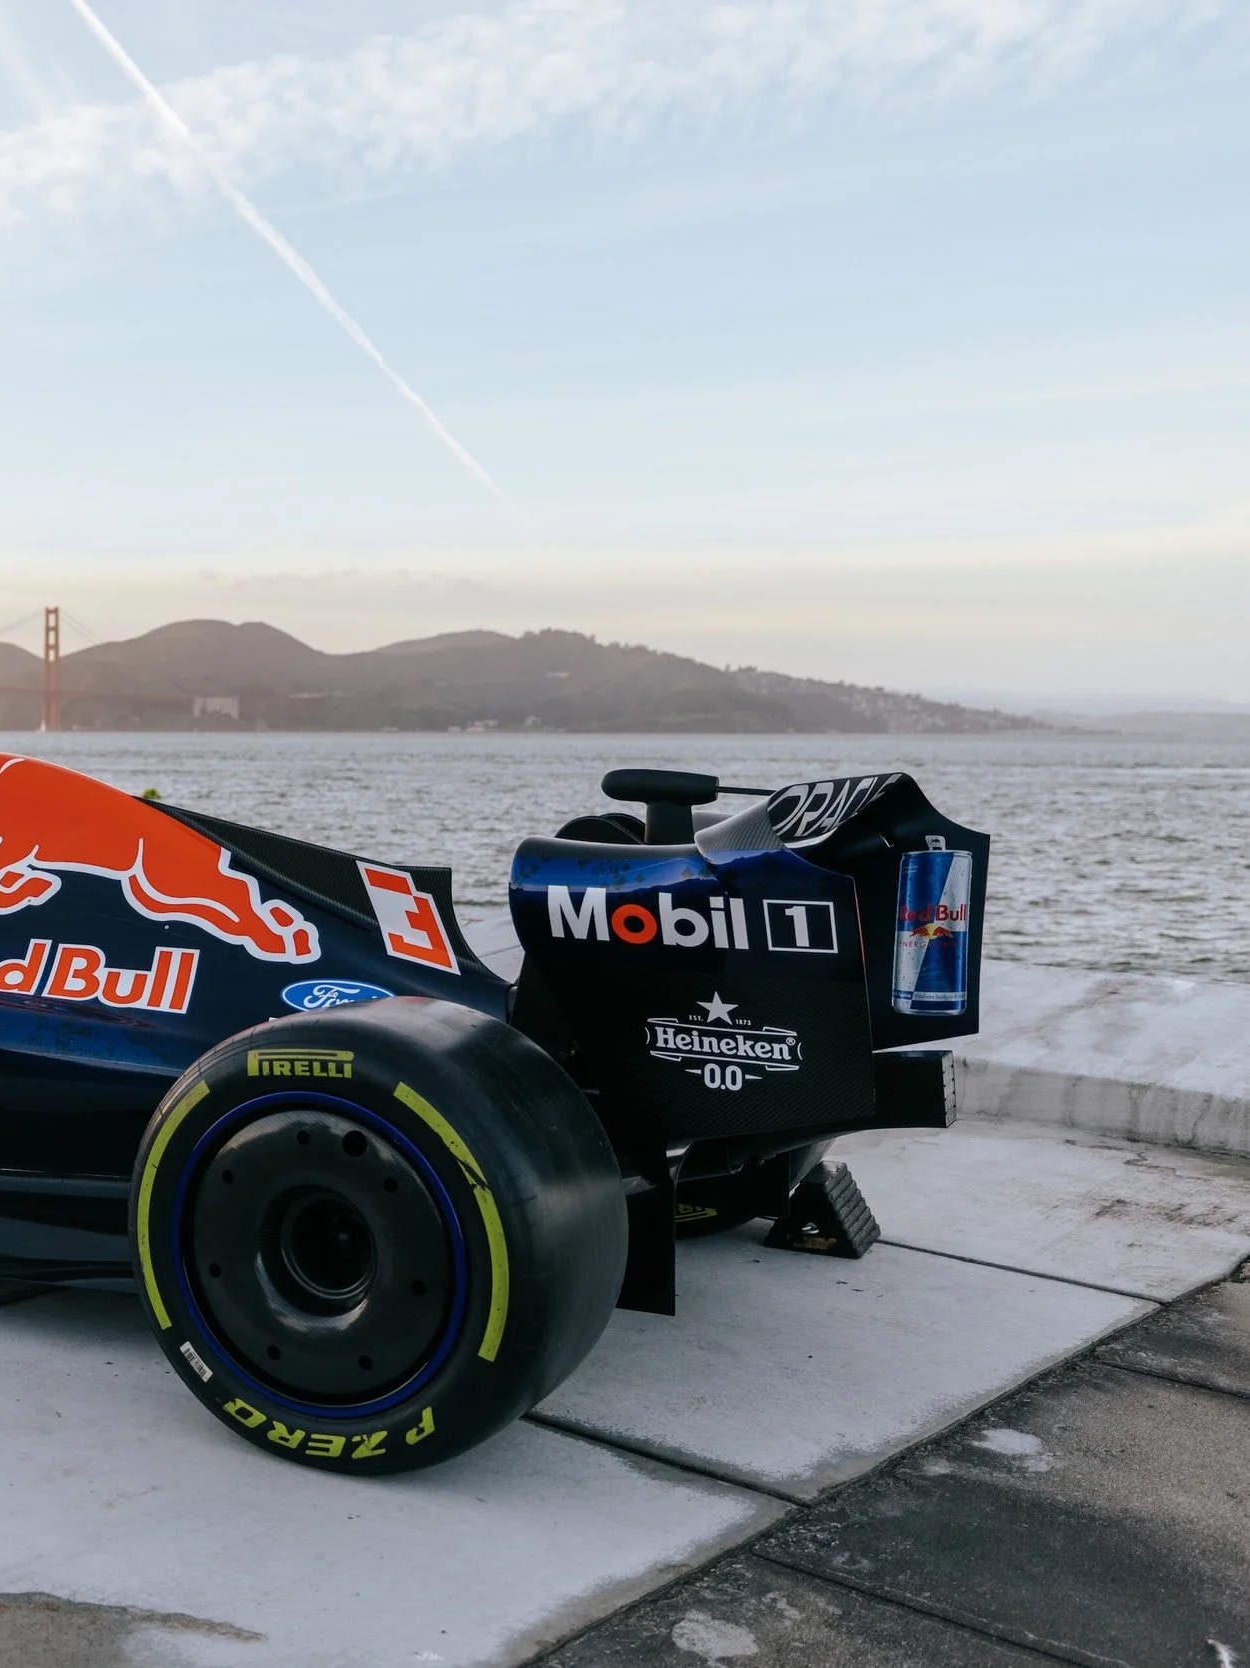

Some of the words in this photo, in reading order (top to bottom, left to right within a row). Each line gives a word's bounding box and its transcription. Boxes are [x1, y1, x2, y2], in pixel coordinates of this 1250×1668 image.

[362, 866, 455, 970] 3
[547, 885, 749, 949] Mobil
[900, 903, 932, 922] Red
[936, 903, 967, 921] Bull
[42, 944, 200, 1014] Bull
[688, 1014, 704, 1022] EST.
[247, 1048, 355, 1078] PIRELLI
[703, 1062, 743, 1091] 0.0
[223, 1397, 388, 1460] ZERO
[405, 1406, 436, 1446] P
